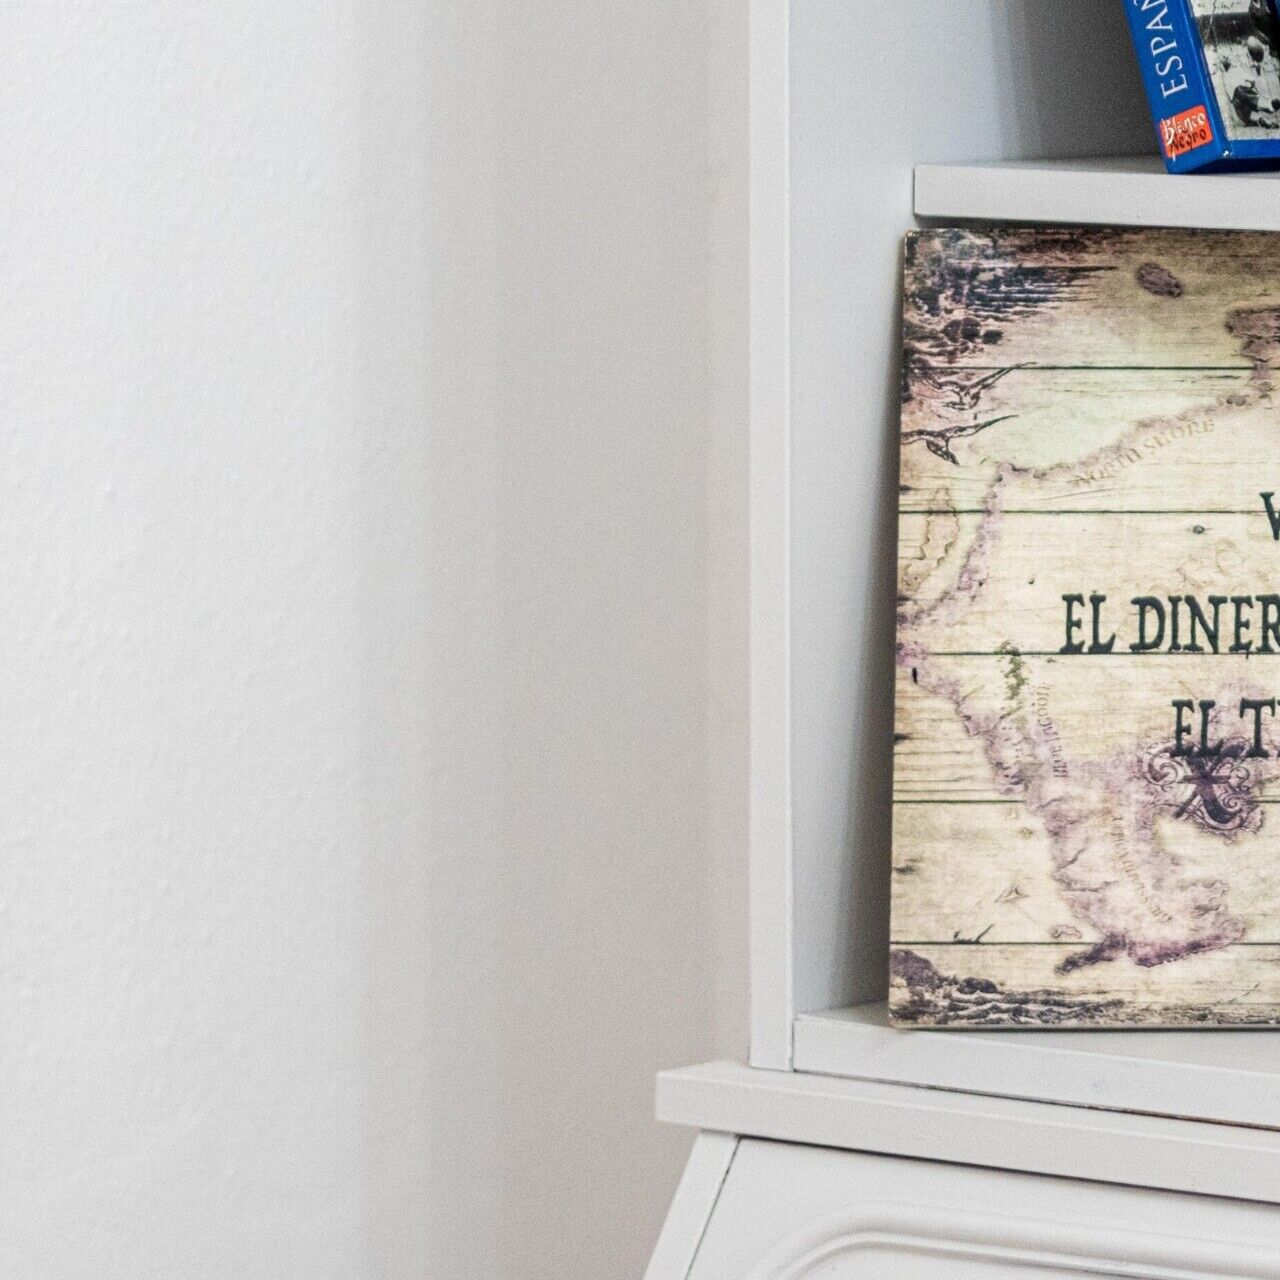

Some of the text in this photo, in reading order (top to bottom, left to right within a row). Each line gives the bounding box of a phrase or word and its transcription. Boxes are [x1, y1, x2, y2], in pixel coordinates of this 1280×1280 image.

[1161, 113, 1205, 145] Blanco
[1170, 129, 1206, 154] Negro
[1059, 593, 1116, 654] EL
[1170, 699, 1223, 758] EL
